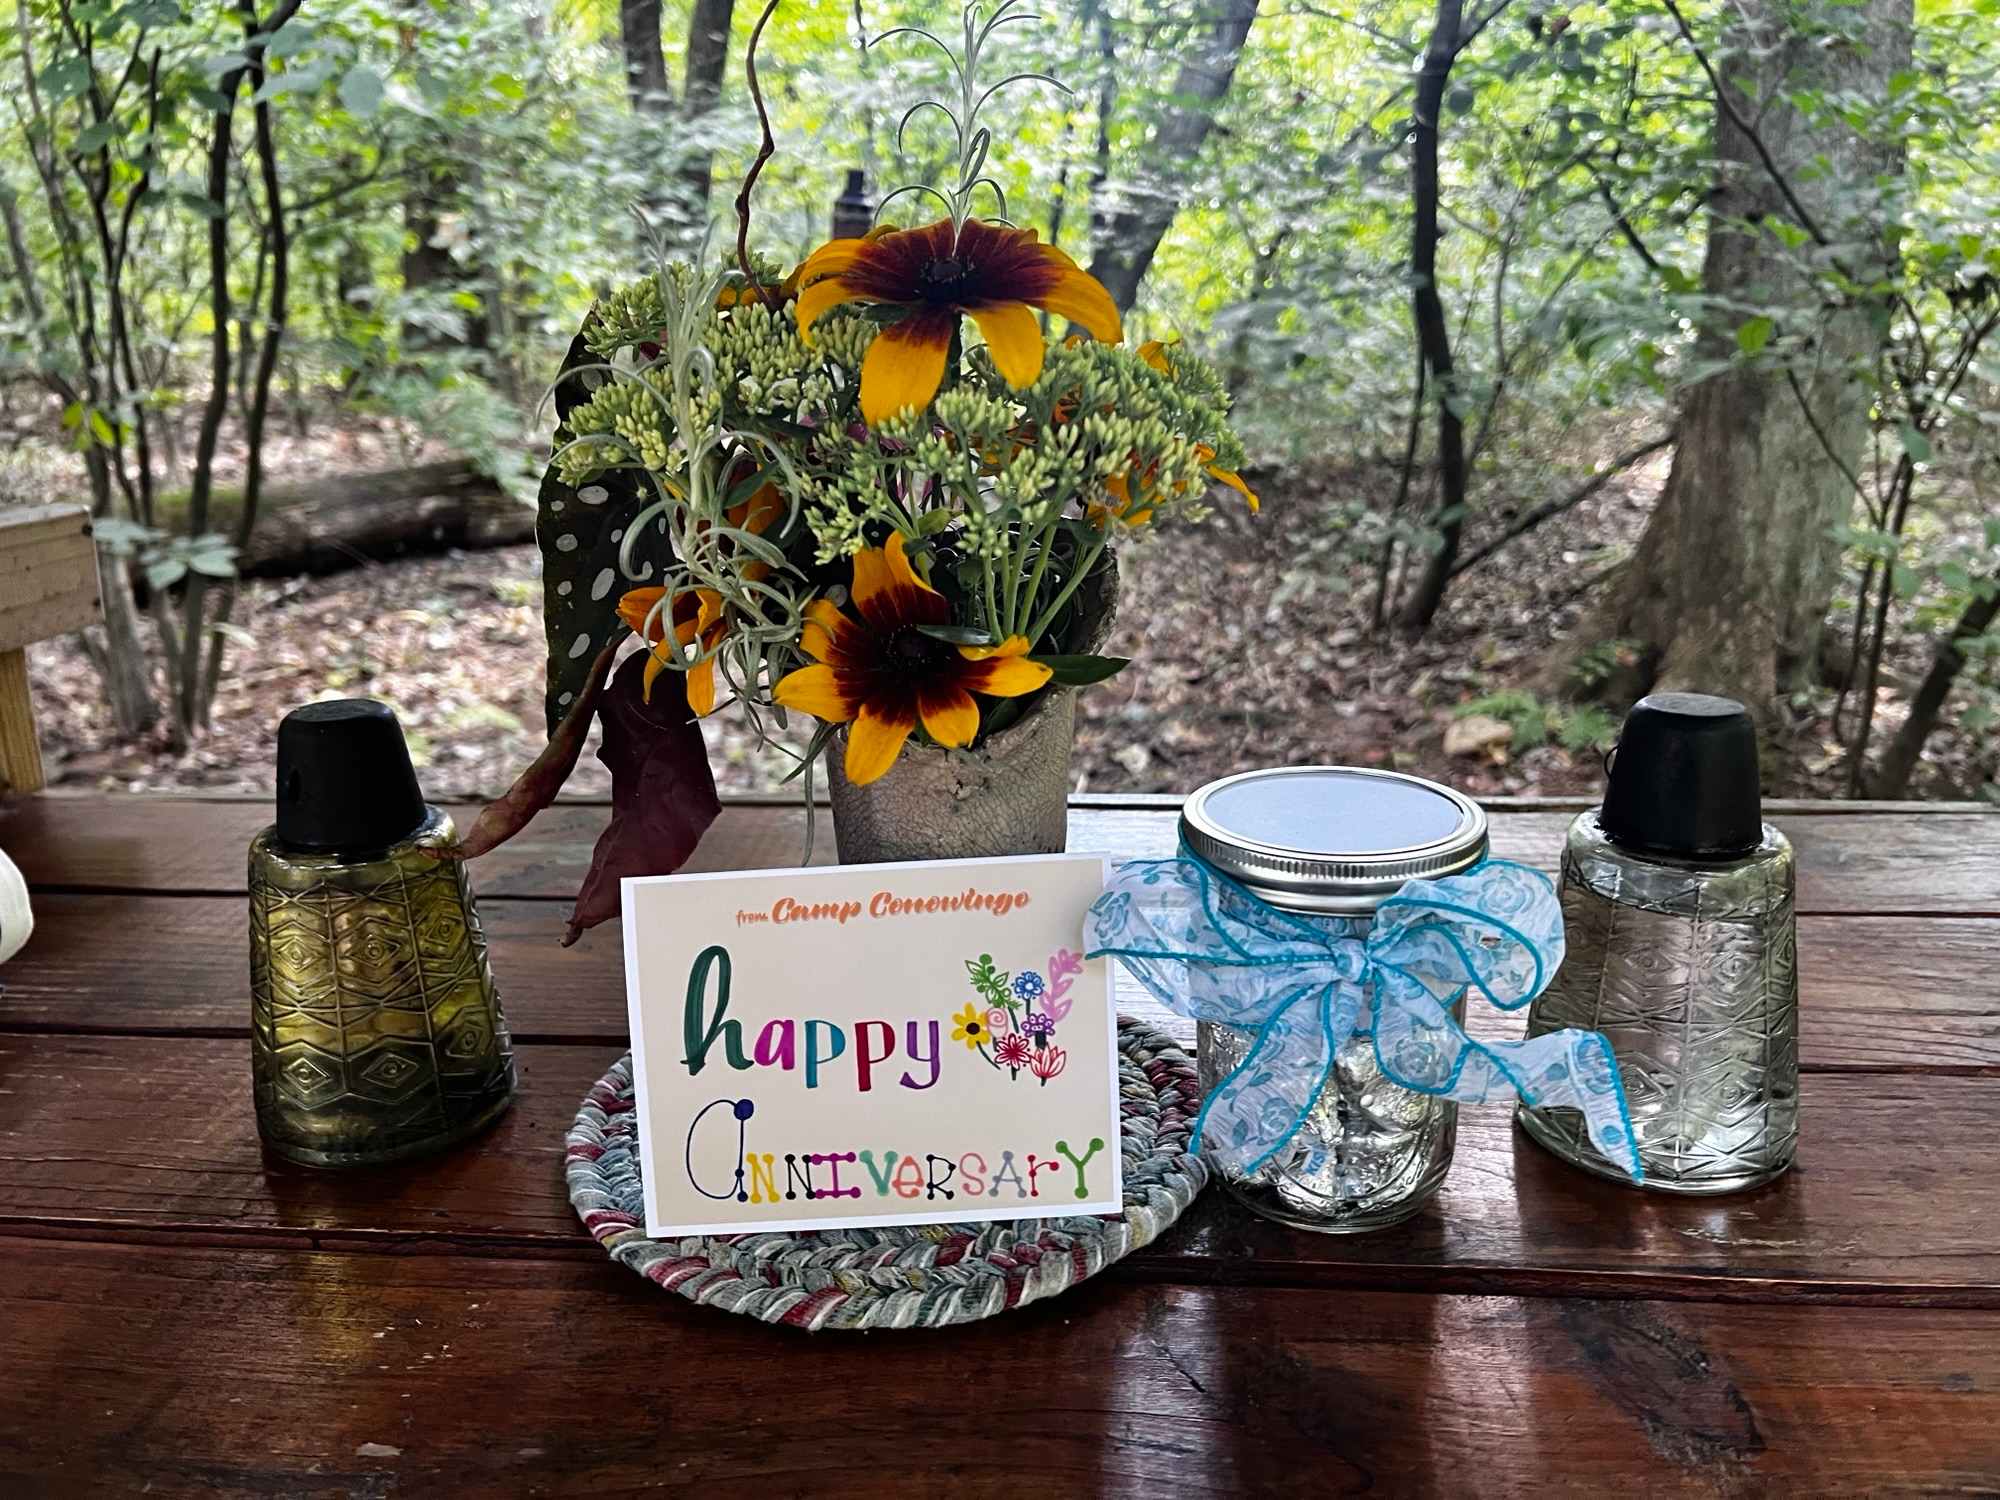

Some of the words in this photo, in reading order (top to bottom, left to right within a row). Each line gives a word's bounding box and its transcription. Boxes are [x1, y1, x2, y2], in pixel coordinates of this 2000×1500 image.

[735, 910, 769, 929] from
[771, 896, 861, 925] Camp
[869, 887, 1029, 917] Conowingo
[680, 945, 941, 1092] happy
